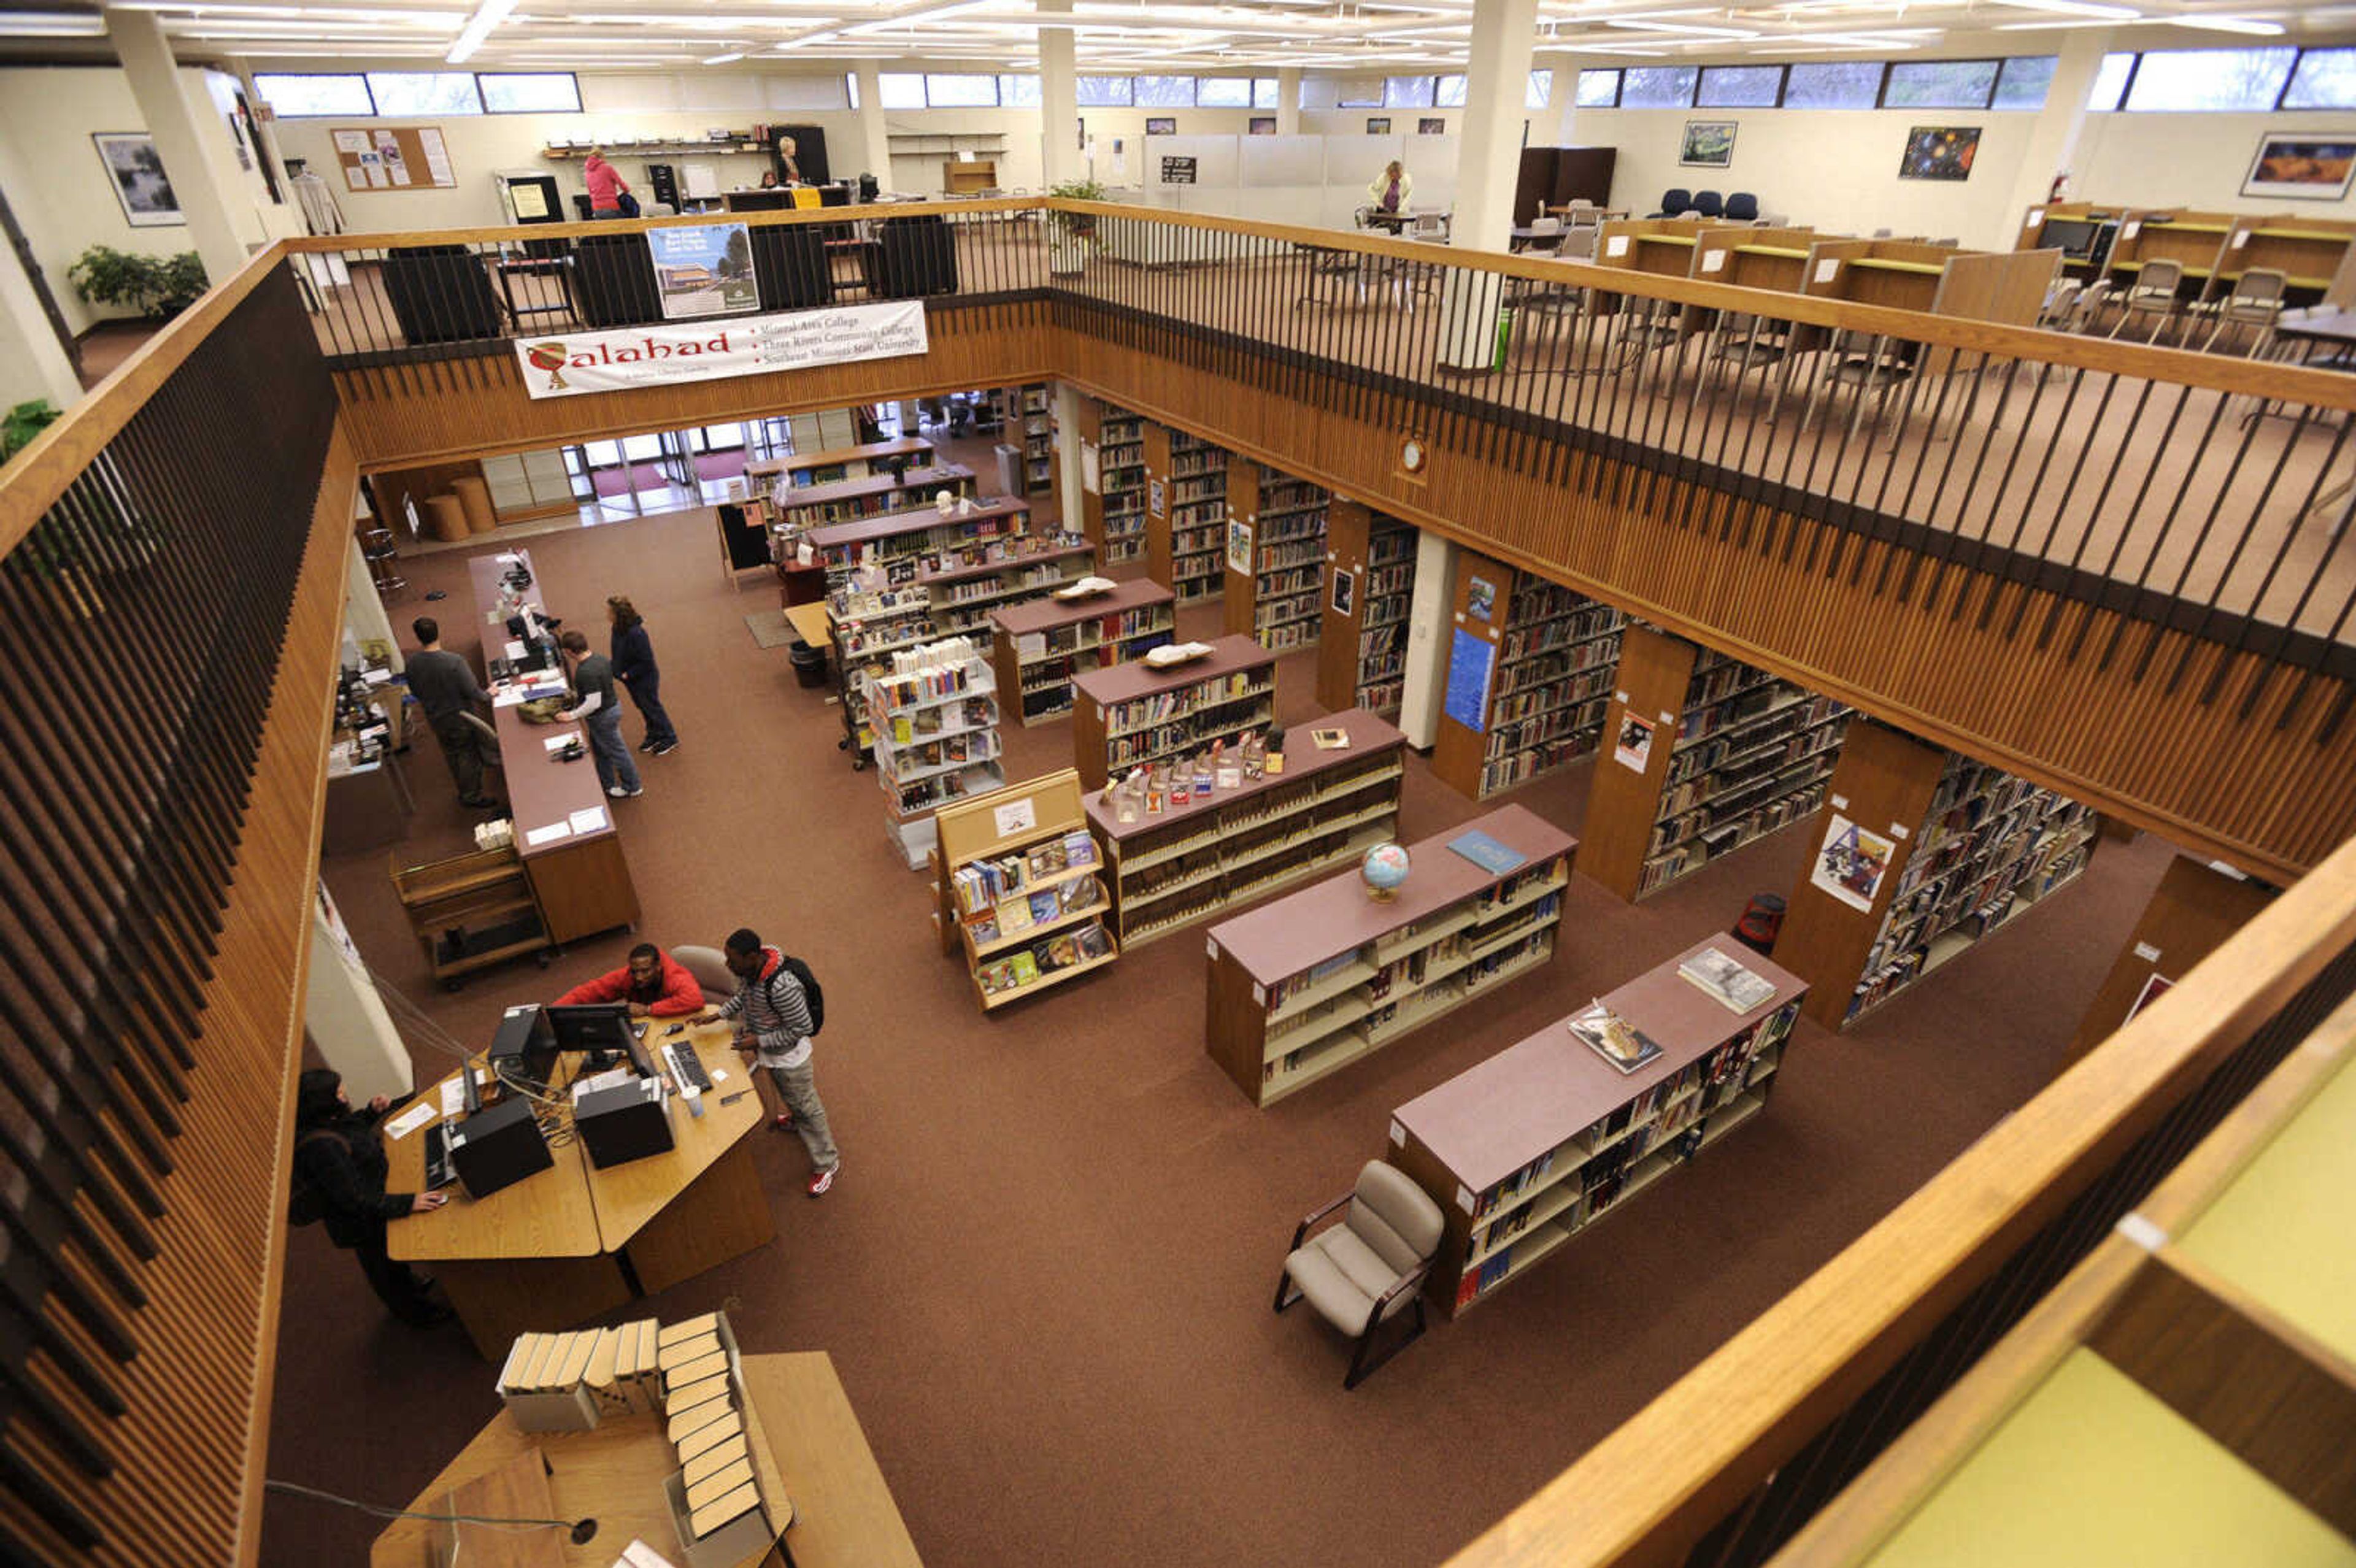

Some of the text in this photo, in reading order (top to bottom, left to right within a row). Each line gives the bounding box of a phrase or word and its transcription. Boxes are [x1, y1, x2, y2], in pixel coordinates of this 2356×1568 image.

[824, 316, 859, 331] College
[880, 323, 913, 337] College
[876, 337, 920, 352] University
